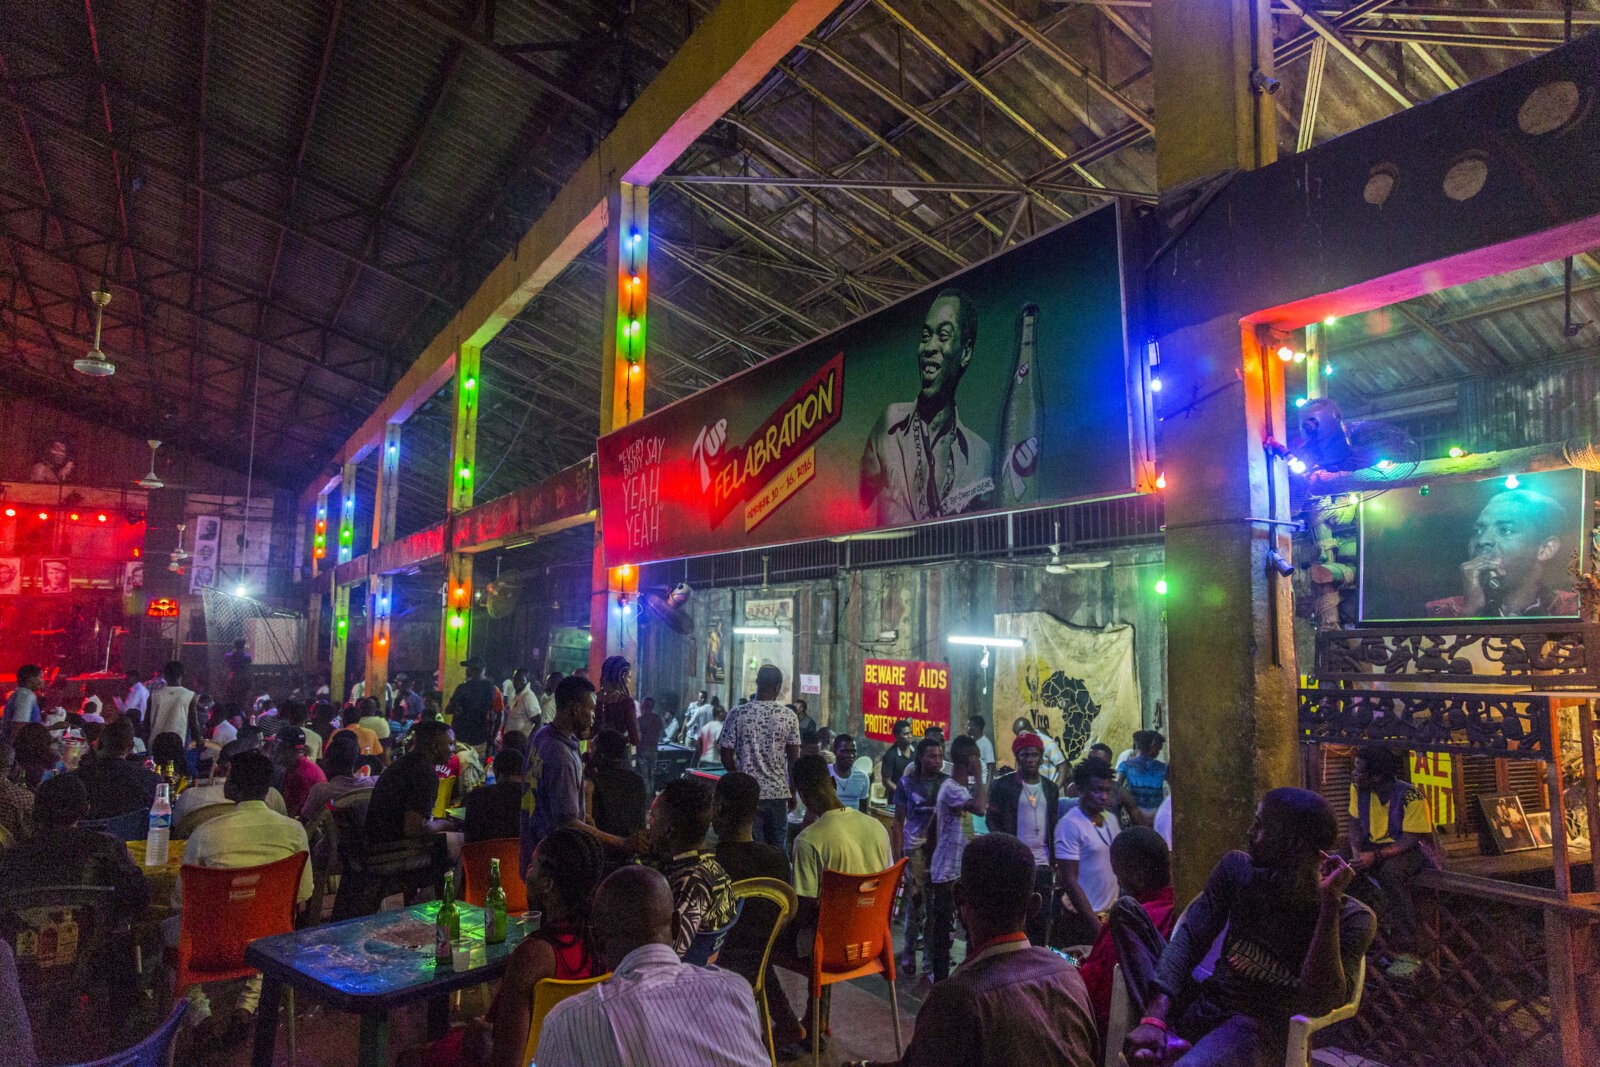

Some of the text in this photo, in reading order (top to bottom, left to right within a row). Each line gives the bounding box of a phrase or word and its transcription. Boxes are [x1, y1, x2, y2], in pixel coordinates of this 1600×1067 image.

[645, 436, 666, 466] SAY
[692, 418, 728, 495] 7UP
[715, 372, 834, 507] FELABRATION
[622, 467, 660, 515] YEAH
[1002, 436, 1039, 501] 7UP
[865, 664, 947, 690] BEWARE AIDS
[878, 690, 929, 713] IS REAL
